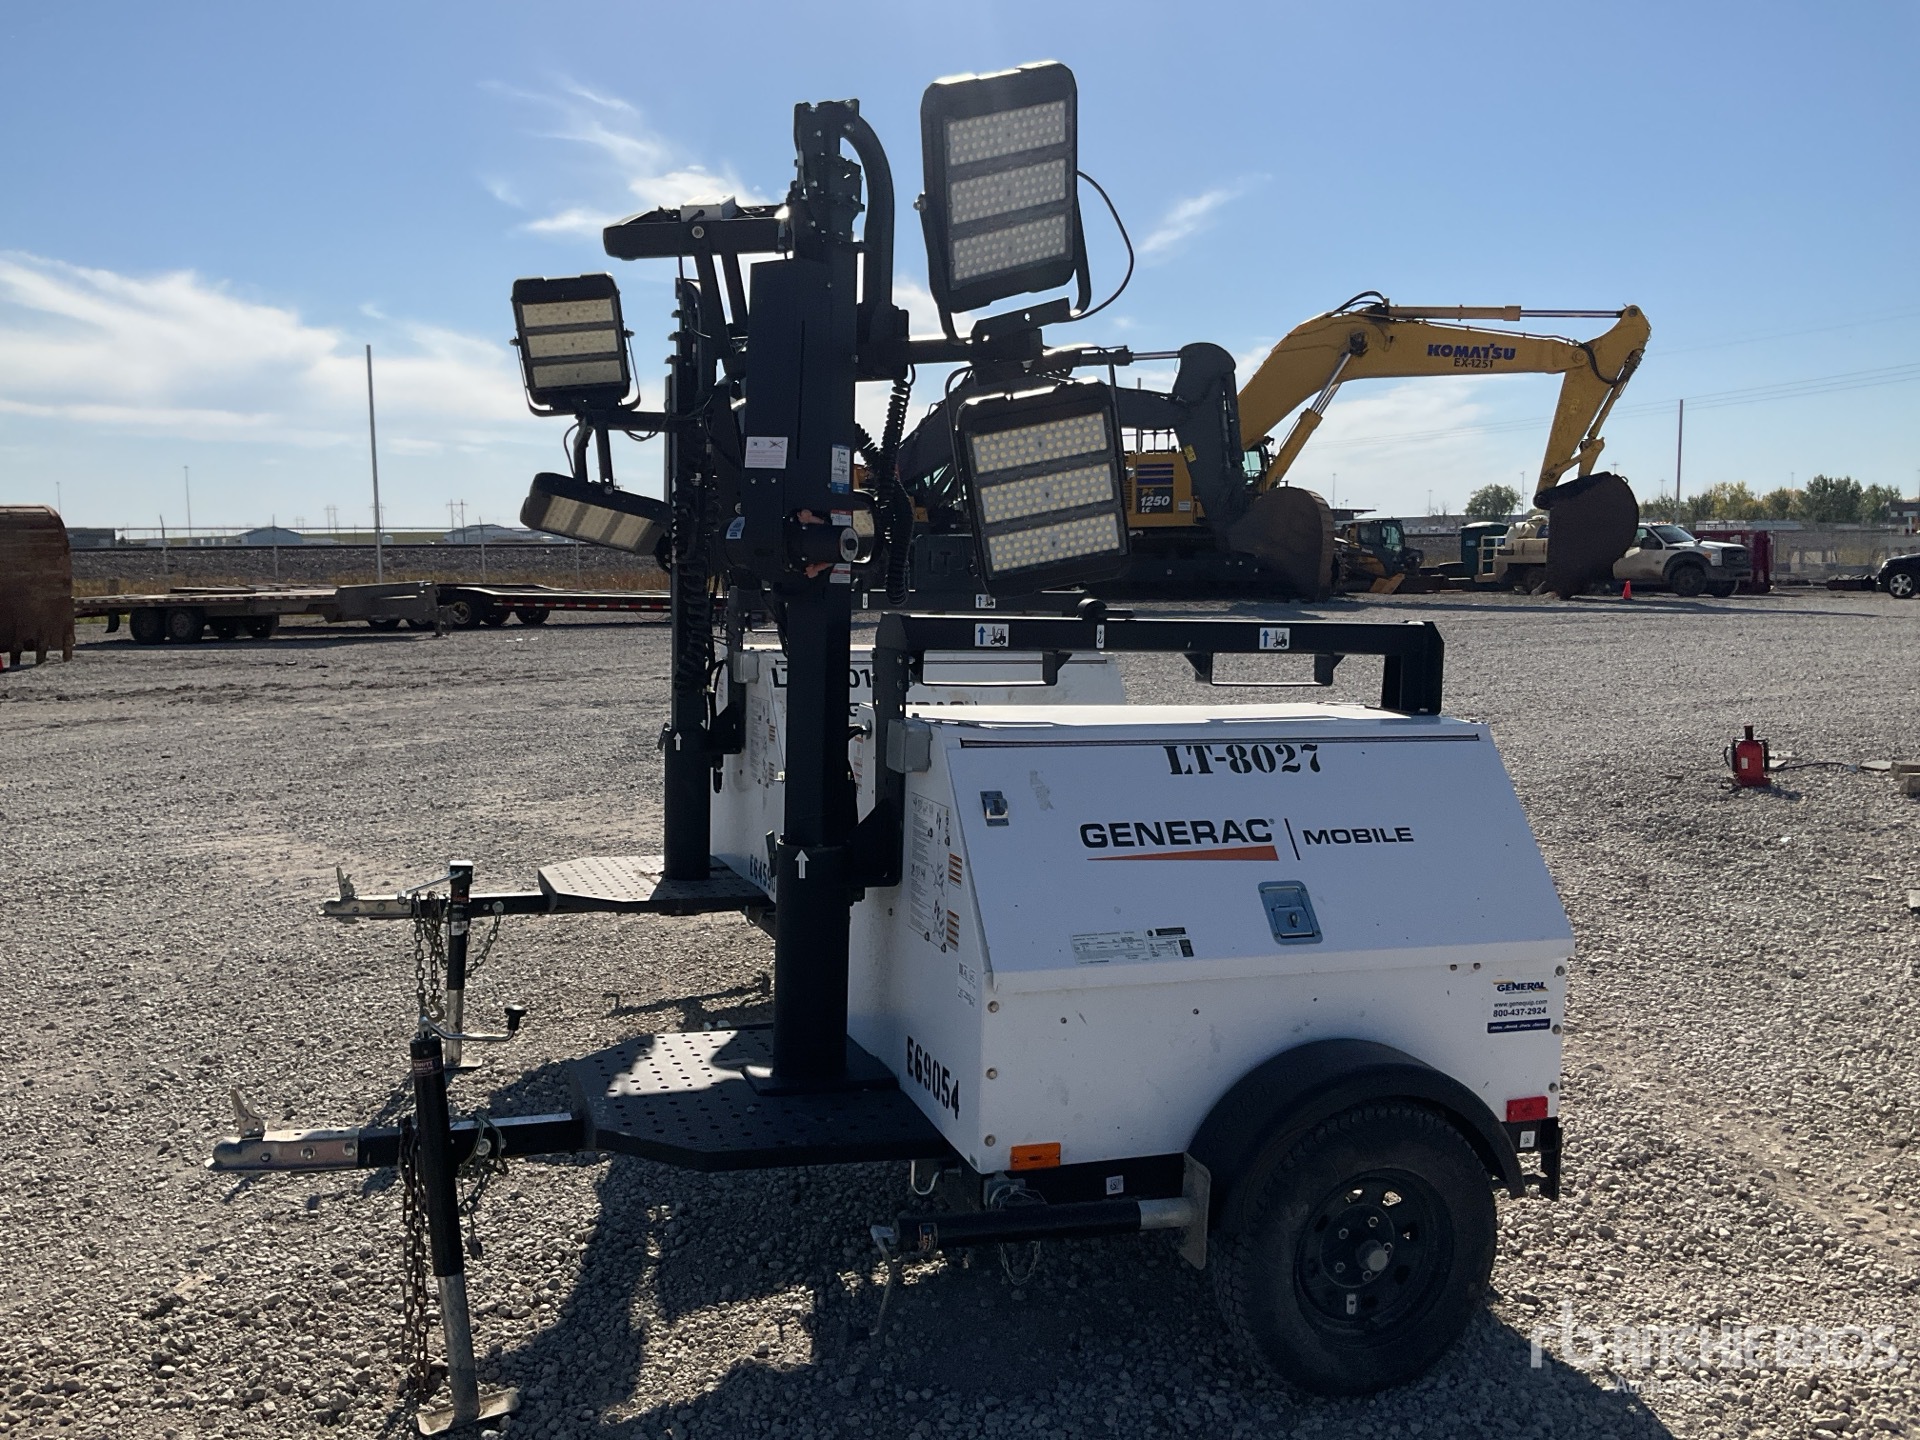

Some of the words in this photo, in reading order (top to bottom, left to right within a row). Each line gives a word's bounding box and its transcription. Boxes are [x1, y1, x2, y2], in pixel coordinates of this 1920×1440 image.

[1427, 343, 1516, 360] KOMATSU
[1453, 357, 1494, 369] EX-1251
[1141, 488, 1155, 496] PC
[1140, 495, 1170, 507] 1250
[1162, 743, 1322, 776] LT-8027
[1079, 818, 1274, 849] GENERAC
[1302, 827, 1415, 846] MOBILE
[1496, 981, 1547, 992] GENERAL
[1493, 999, 1548, 1008] www.genequip.com
[1493, 1006, 1547, 1018] 800-437-2924
[906, 1034, 960, 1121] E69054
